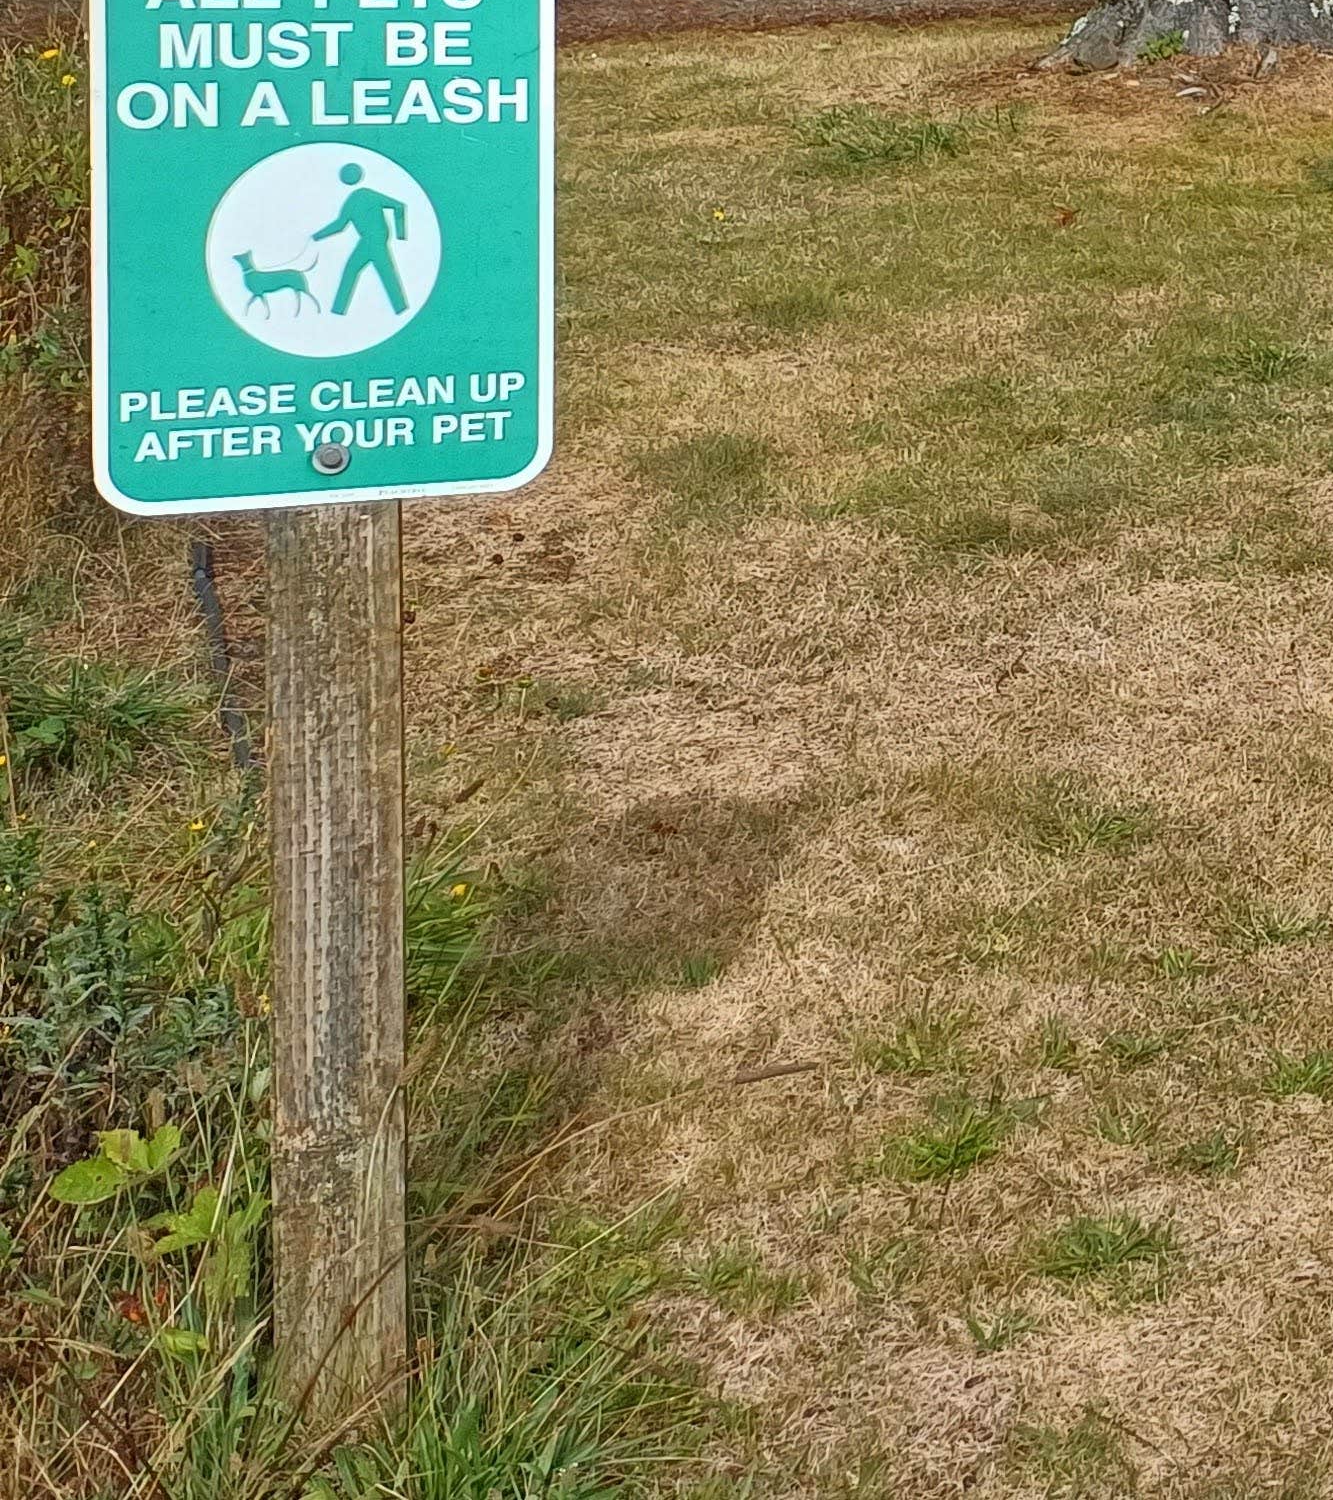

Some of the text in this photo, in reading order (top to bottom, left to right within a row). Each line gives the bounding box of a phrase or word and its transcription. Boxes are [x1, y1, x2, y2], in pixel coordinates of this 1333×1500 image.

[159, 21, 473, 69] MUST BE
[116, 76, 528, 130] ON A LEASH
[119, 371, 525, 423] PLEASE CLEAN UP
[134, 410, 512, 463] AFTER YOUR PET
